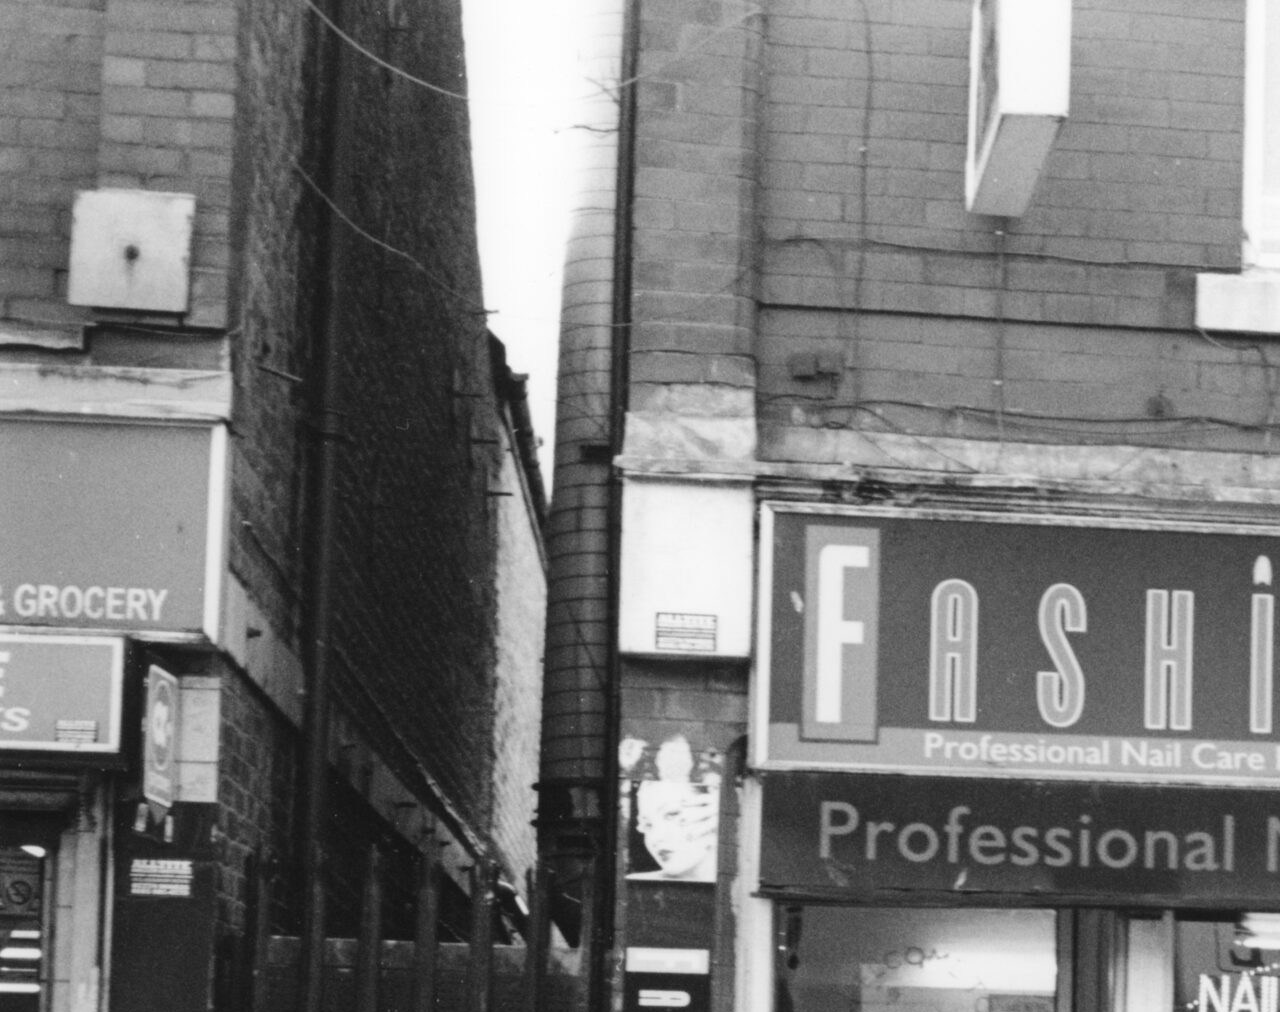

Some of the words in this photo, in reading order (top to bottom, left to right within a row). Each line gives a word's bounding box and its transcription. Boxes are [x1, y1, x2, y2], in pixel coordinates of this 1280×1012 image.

[14, 583, 169, 621] GROCERY
[923, 733, 1110, 768] Professional
[1120, 739, 1182, 770] Nail
[1192, 743, 1267, 772] Care
[818, 801, 1235, 873] Professional
